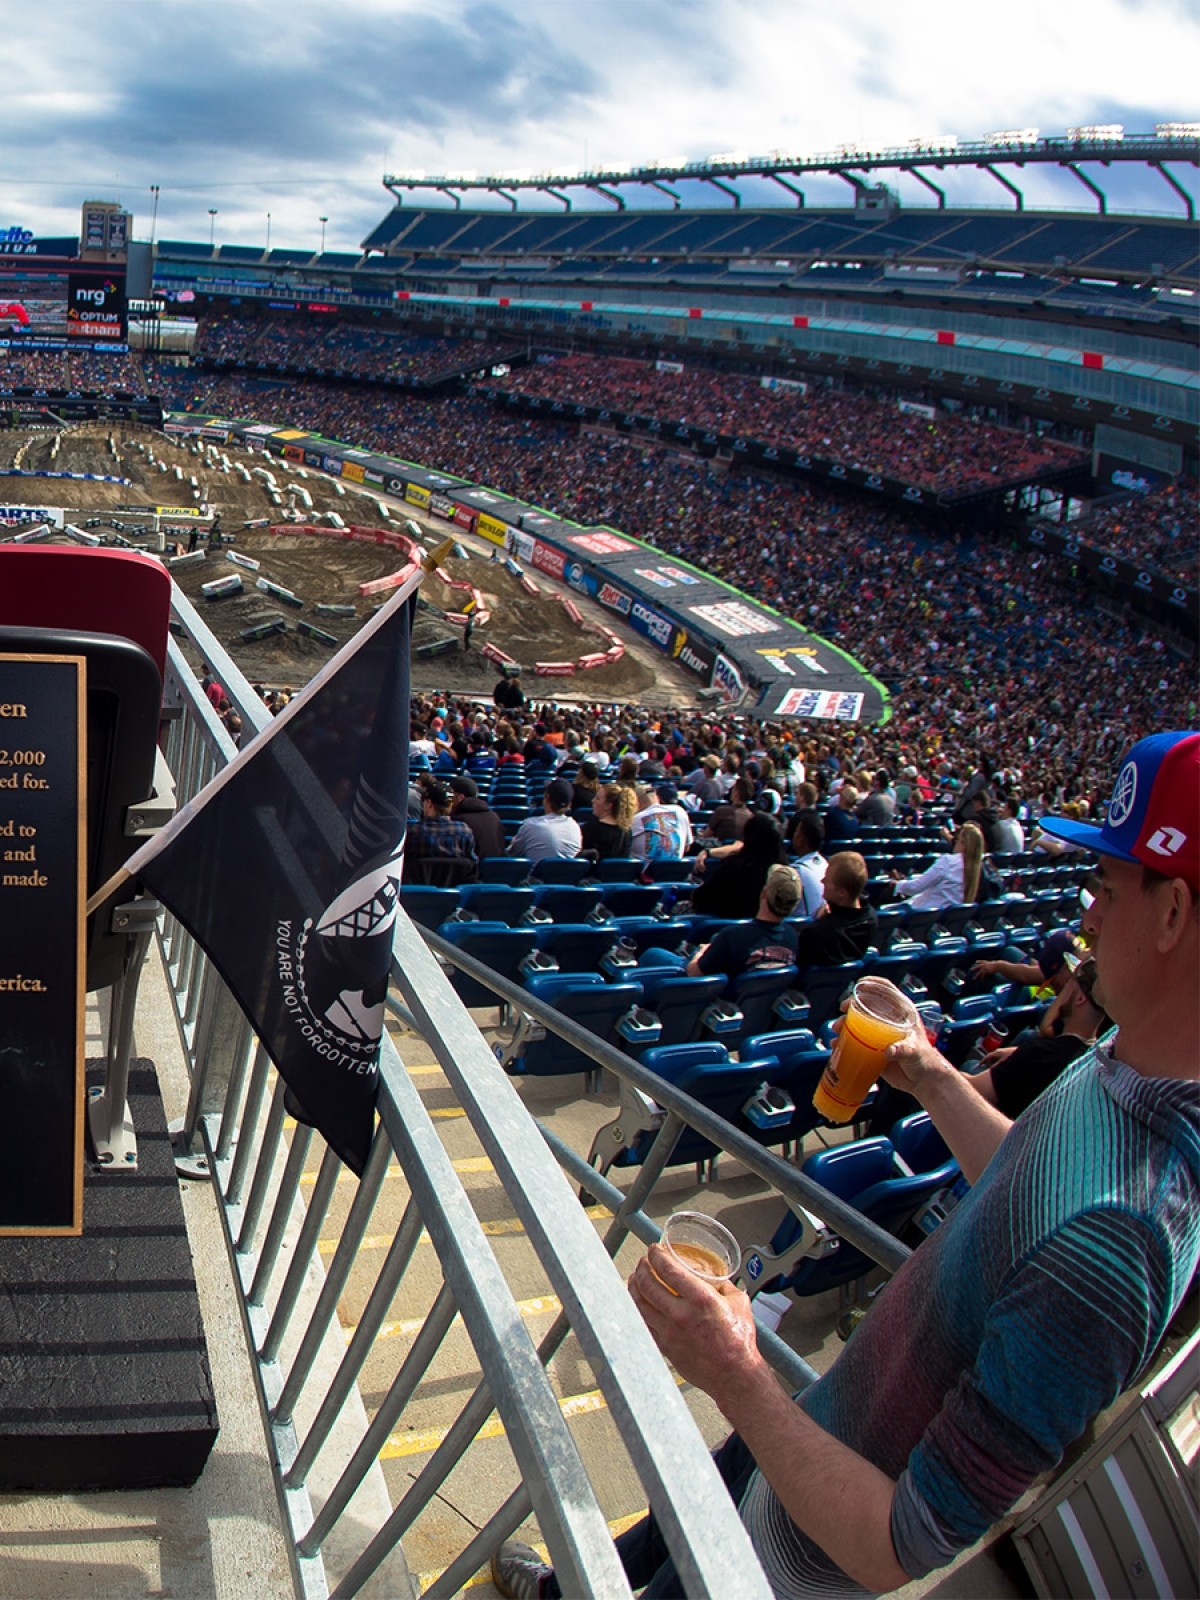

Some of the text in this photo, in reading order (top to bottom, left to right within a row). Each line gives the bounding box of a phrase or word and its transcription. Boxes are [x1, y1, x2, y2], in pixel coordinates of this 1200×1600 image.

[76, 288, 106, 307] nrg
[79, 311, 119, 323] OPTUM
[66, 321, 121, 337] Putnam
[479, 519, 506, 538] DUNLOP
[599, 583, 631, 613] AMSOIL
[631, 603, 673, 636] COOPER
[680, 646, 708, 674] thor
[22, 772, 50, 789] for.
[19, 824, 37, 837] to
[3, 844, 36, 862] and
[3, 868, 48, 887] made
[276, 919, 379, 1076] YOU ARE NOT FORGOTTEN
